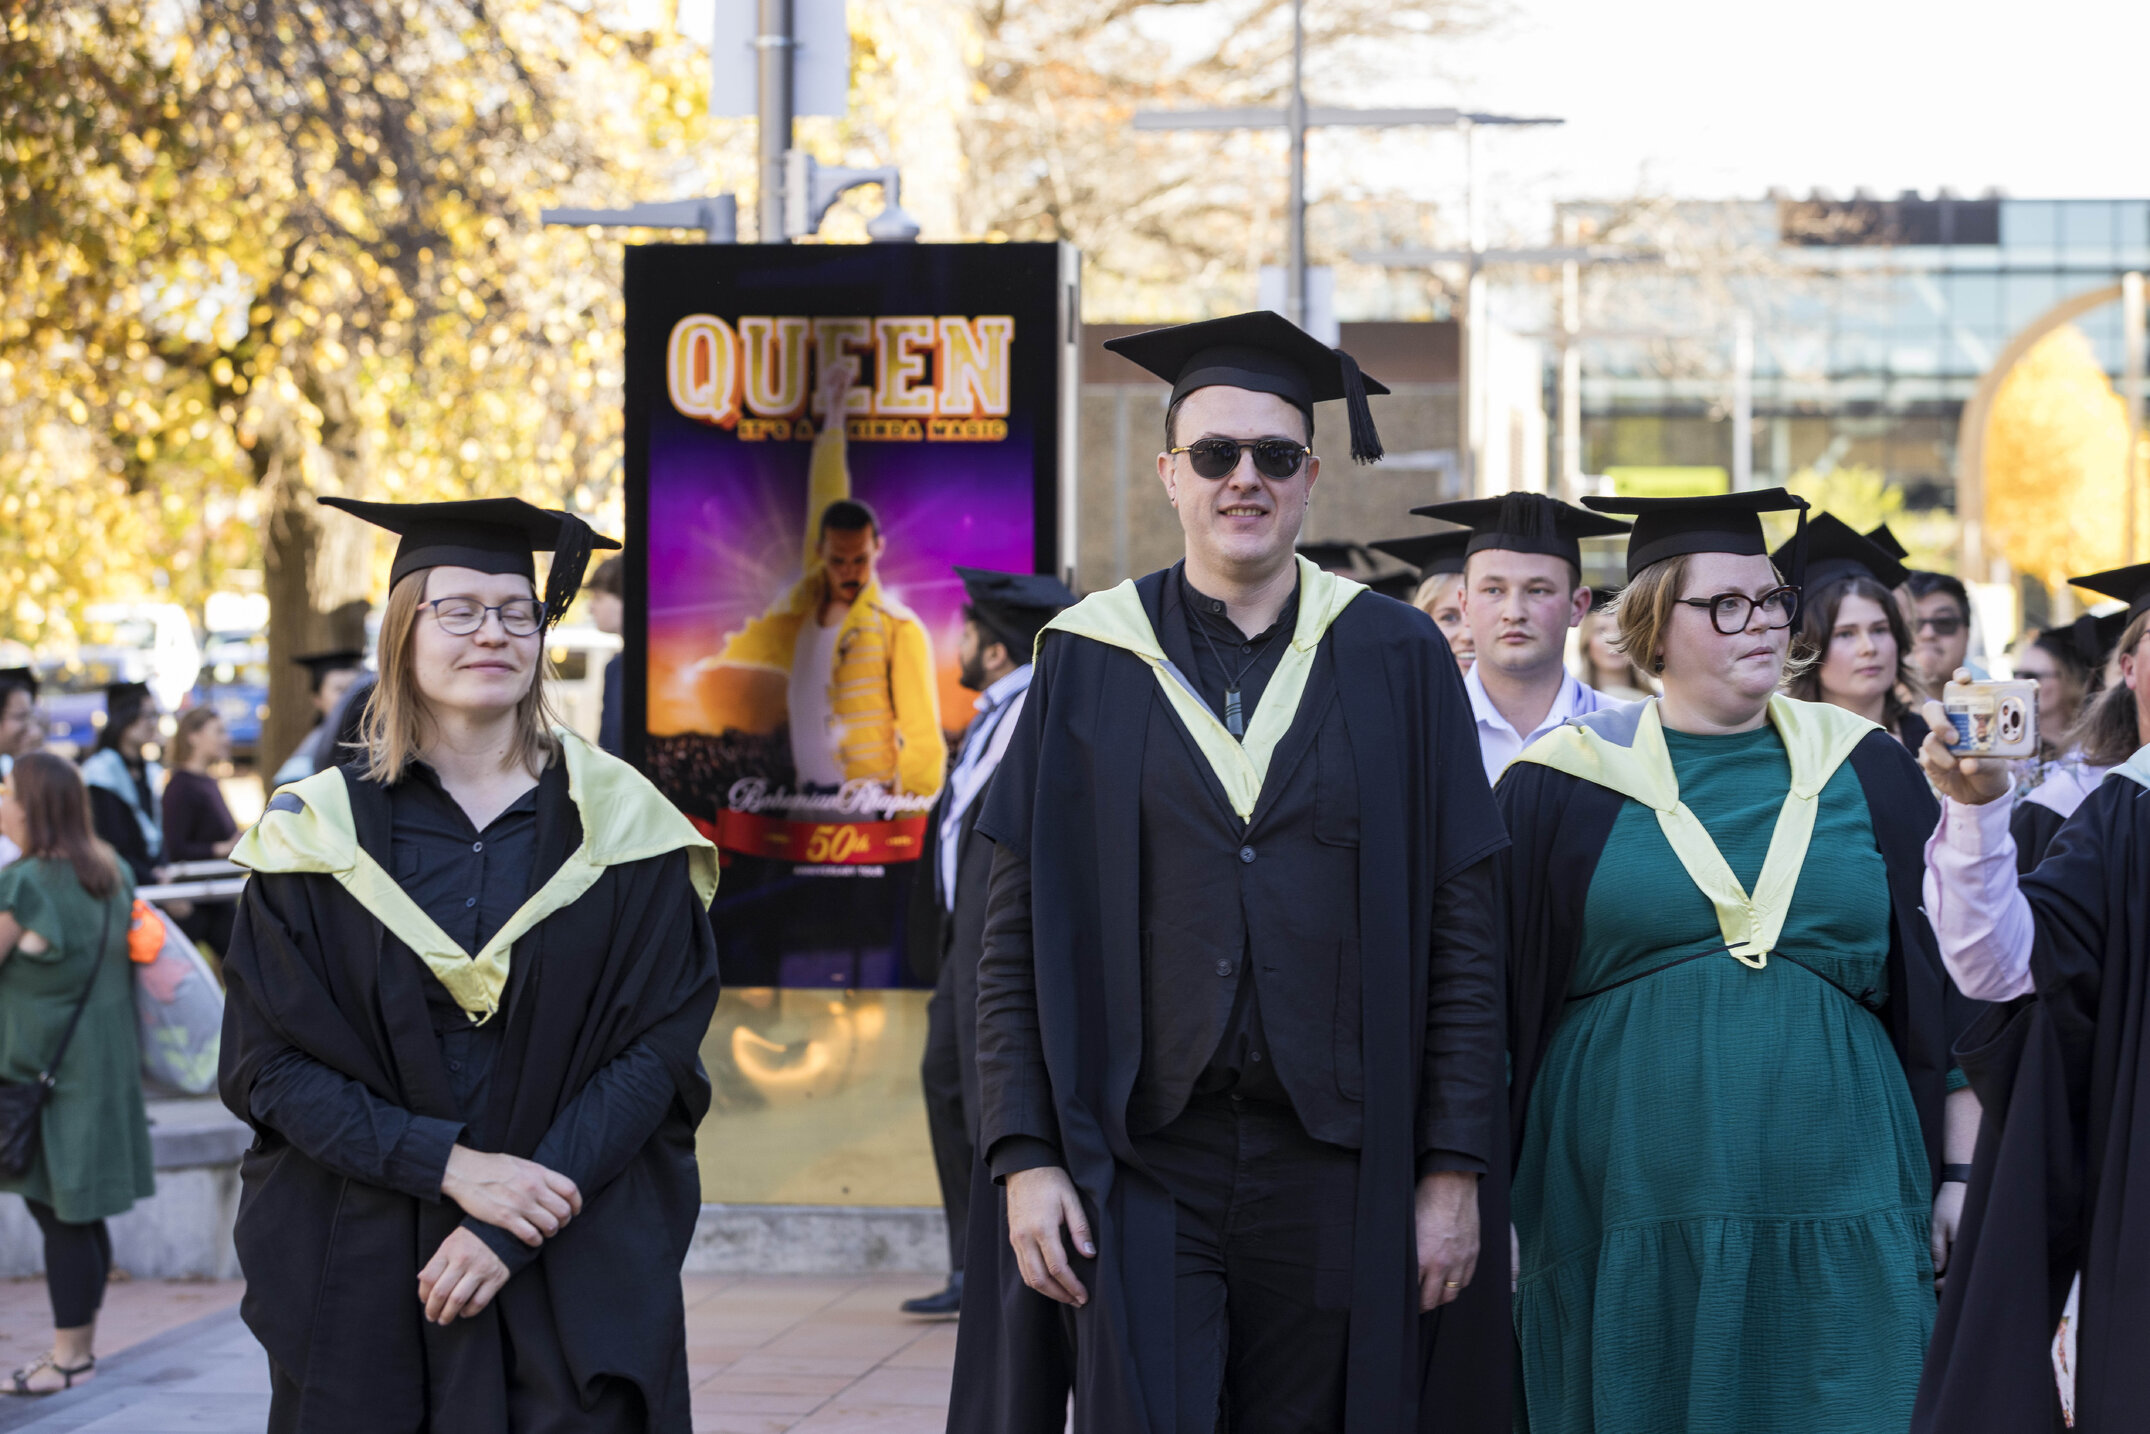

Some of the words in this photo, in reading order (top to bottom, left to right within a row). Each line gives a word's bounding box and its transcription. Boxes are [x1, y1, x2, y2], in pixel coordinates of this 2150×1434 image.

[667, 314, 1014, 425] QUEEN
[926, 419, 1009, 441] MAGIC
[728, 777, 840, 813] Bohemian
[806, 825, 870, 862] 50th
